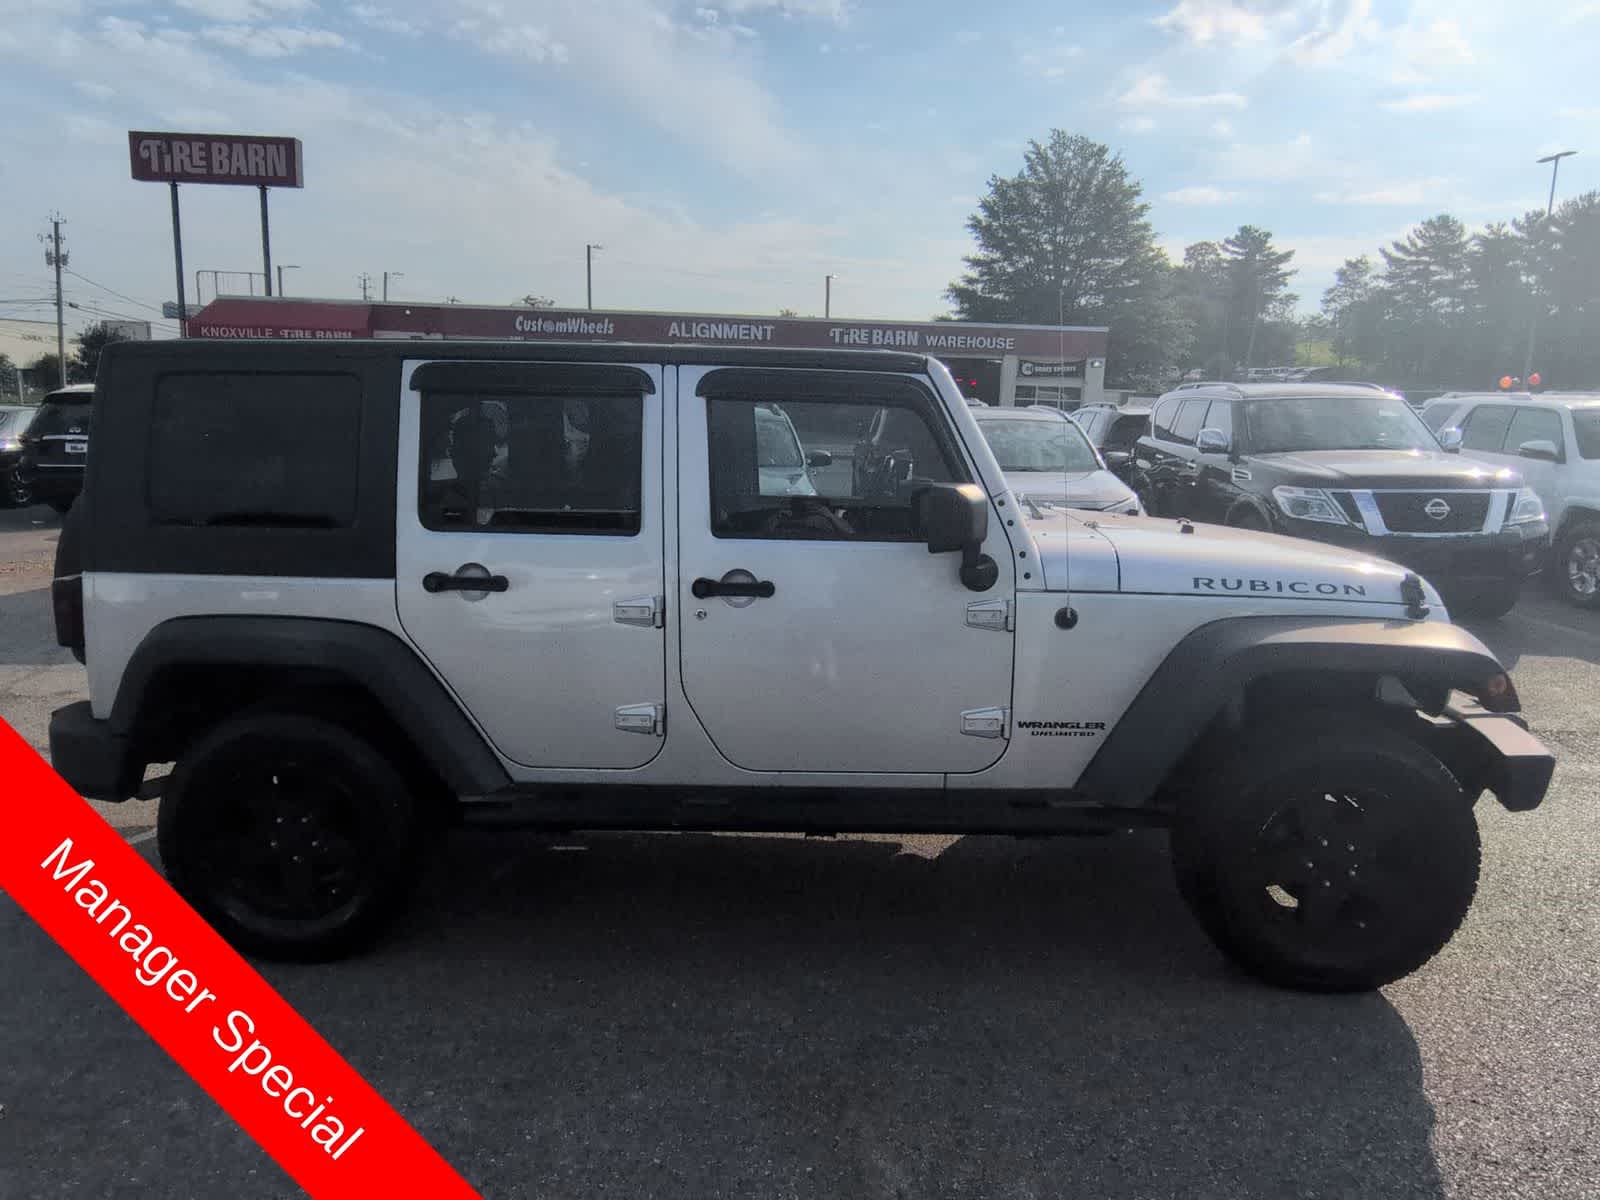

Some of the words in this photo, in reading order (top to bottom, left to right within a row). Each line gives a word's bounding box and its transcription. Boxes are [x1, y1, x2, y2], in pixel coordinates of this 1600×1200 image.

[211, 142, 287, 177] BARN
[200, 326, 273, 339] KNOXVILLE
[668, 321, 775, 341] ALIGNMENT
[872, 328, 919, 347] BARN
[926, 335, 1016, 350] WAREHOUSE
[1192, 577, 1367, 597] RUBICON
[1017, 720, 1106, 731] WRANGLER
